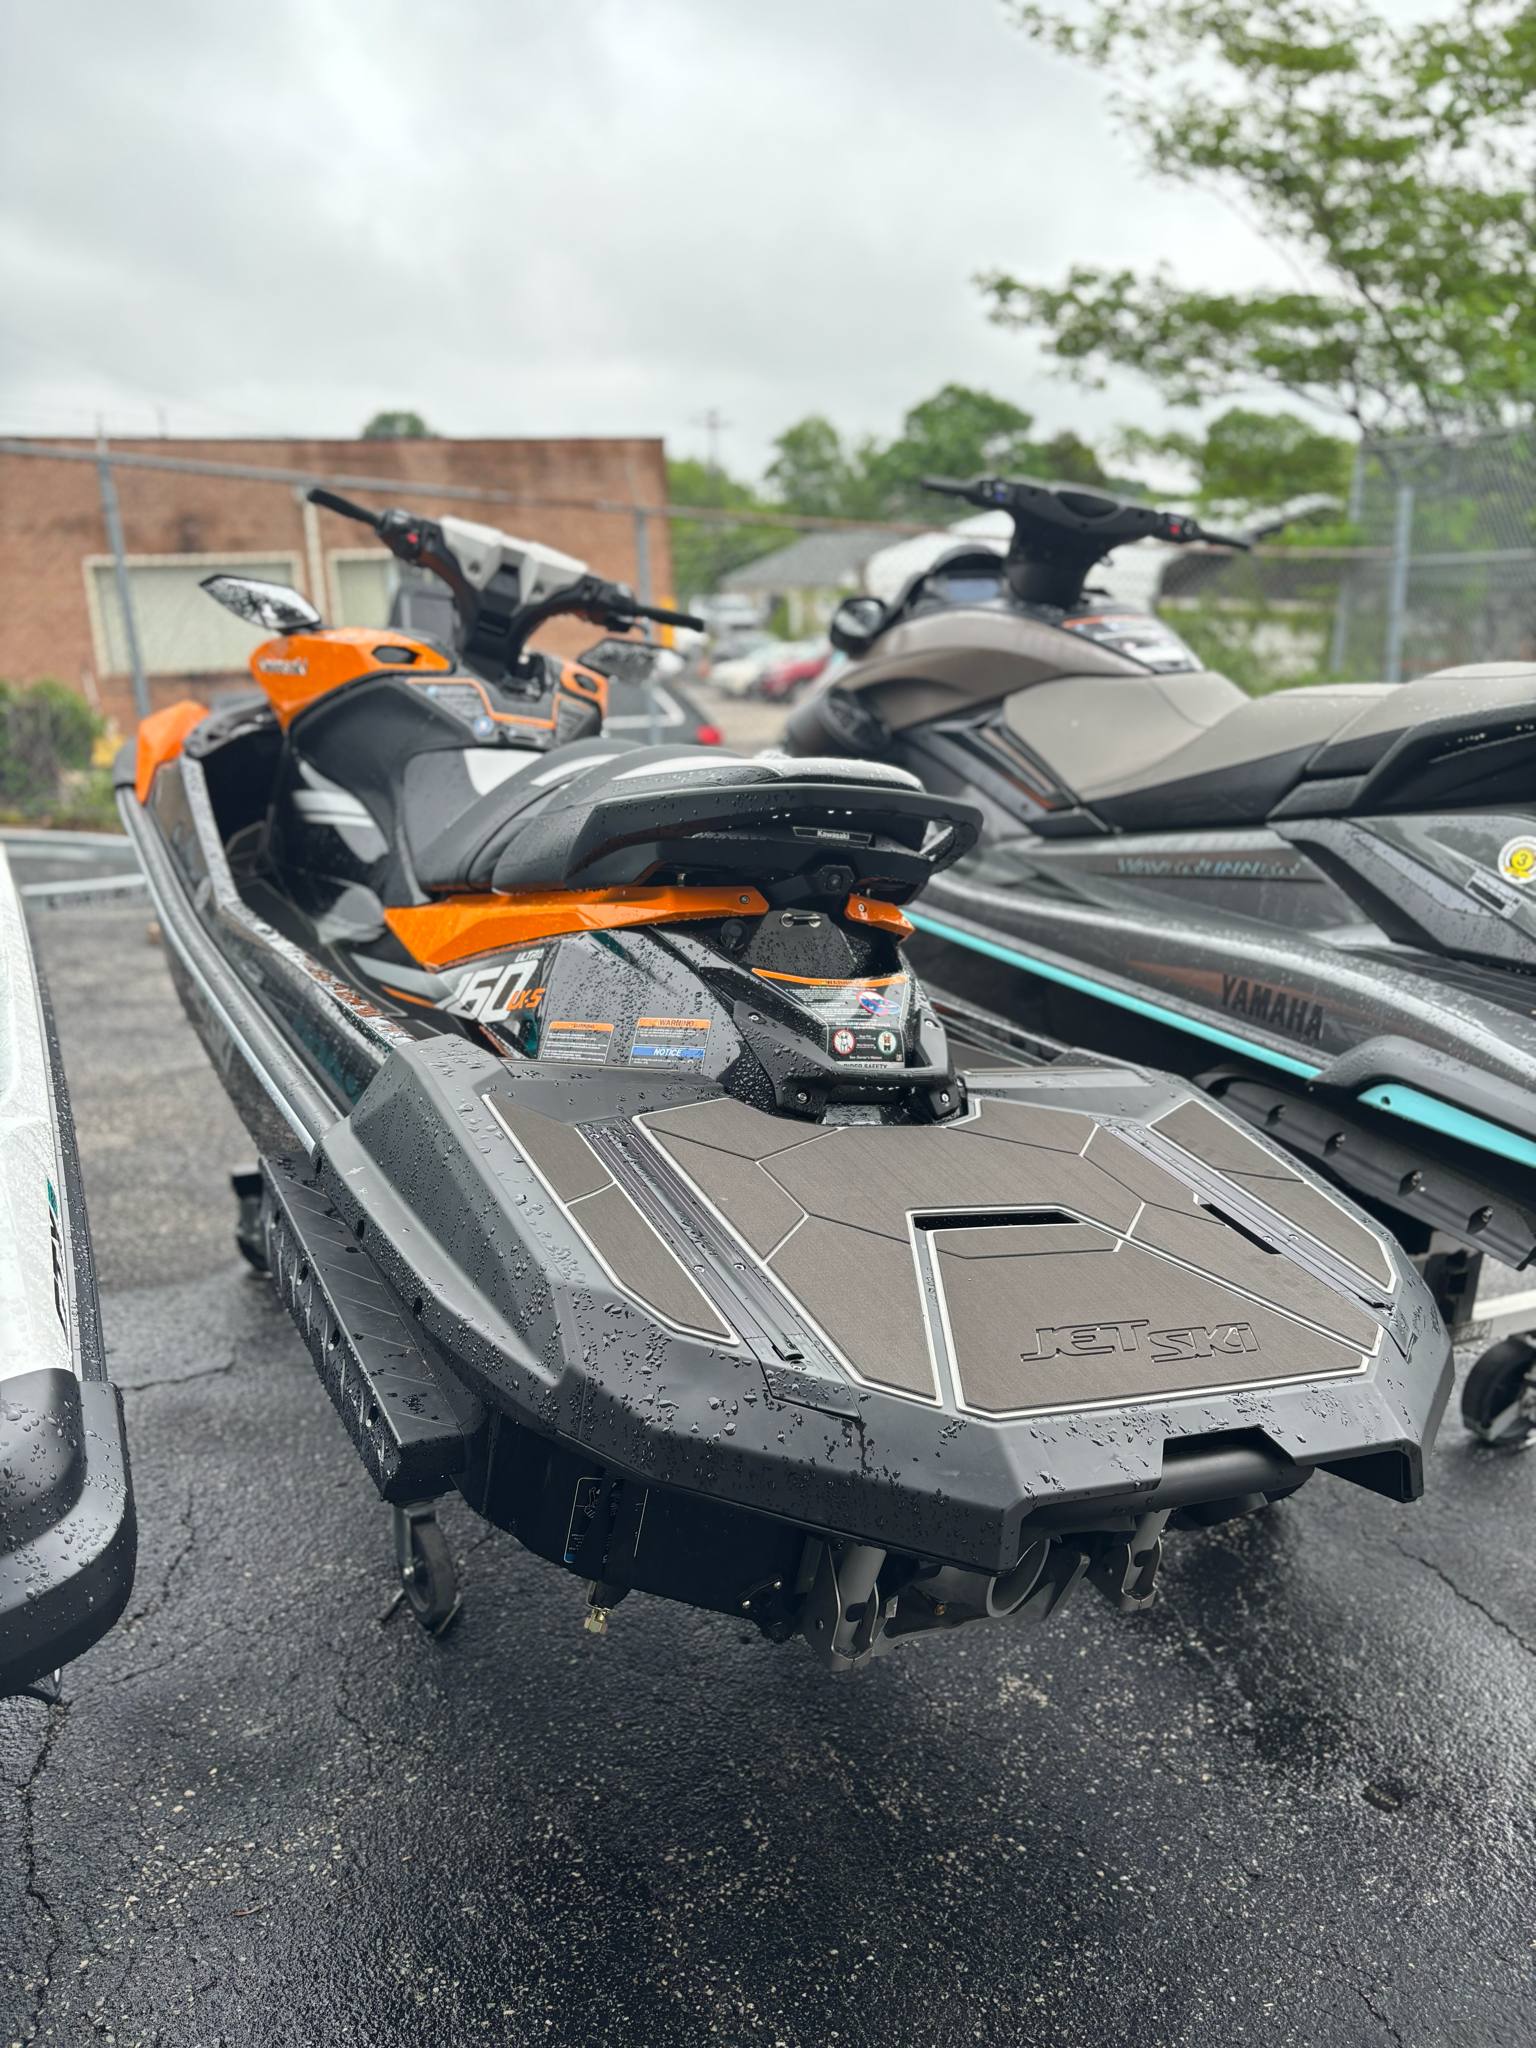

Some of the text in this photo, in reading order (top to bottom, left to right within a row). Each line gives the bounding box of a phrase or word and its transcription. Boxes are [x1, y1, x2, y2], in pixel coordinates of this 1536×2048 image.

[816, 828, 850, 841] Kawasaki
[1221, 973, 1323, 1040] YAMAHA
[658, 1019, 695, 1028] WARNING
[653, 1048, 683, 1057] NOTICE
[1020, 1319, 1262, 1363] JET SKI
